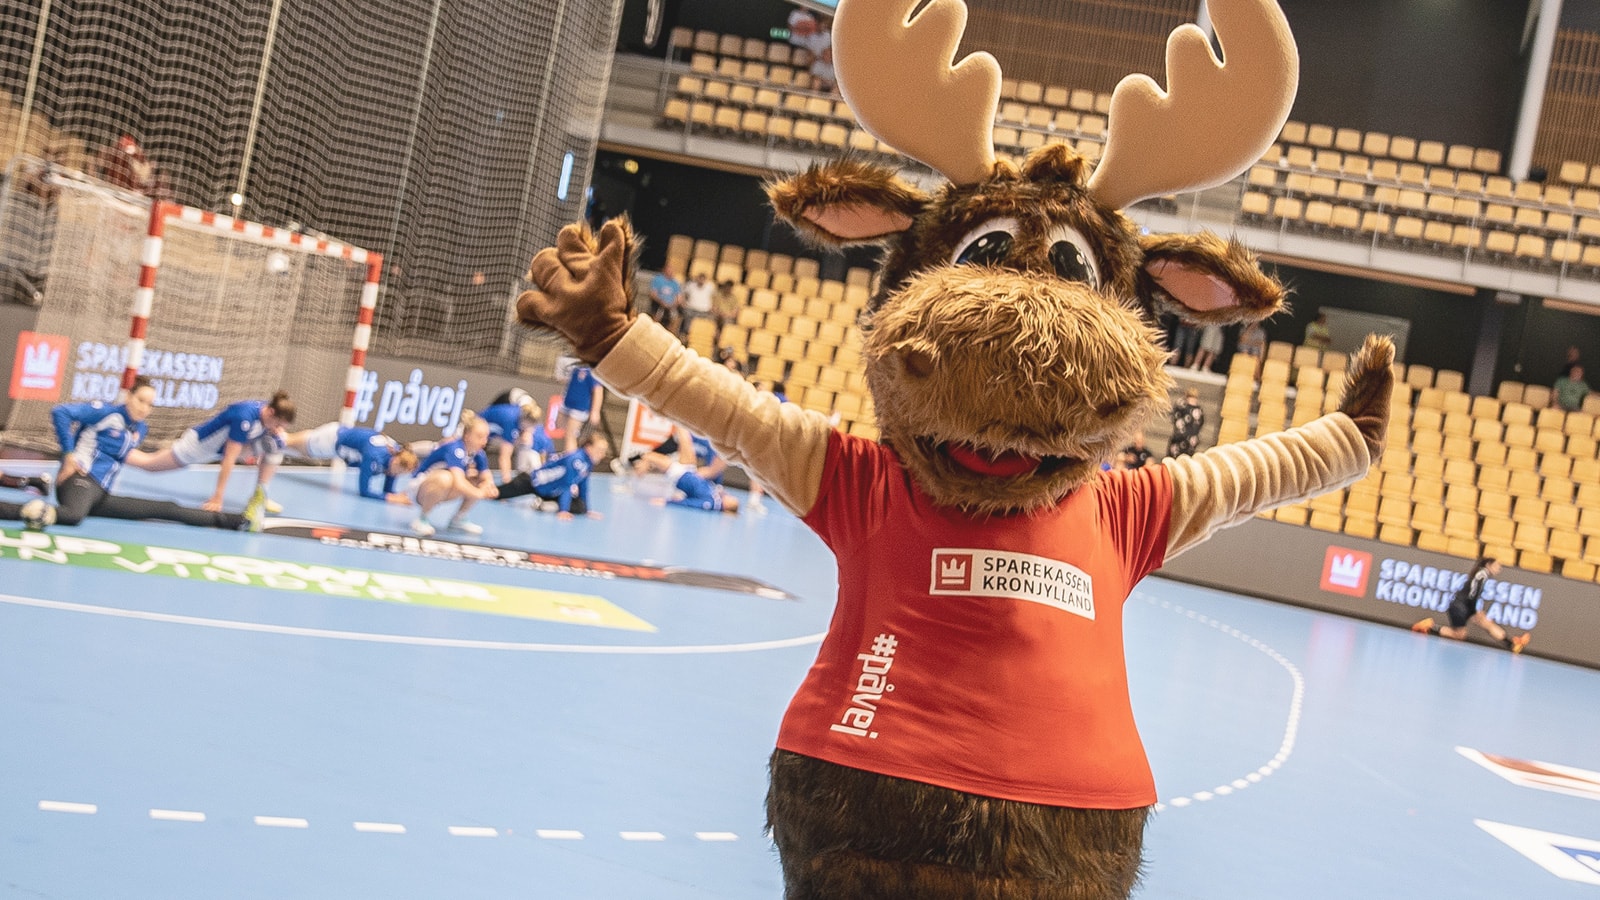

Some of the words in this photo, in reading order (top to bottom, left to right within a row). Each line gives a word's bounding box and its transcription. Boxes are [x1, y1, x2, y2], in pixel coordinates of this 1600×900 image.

[71, 372, 219, 410] KROLLAND
[982, 574, 1093, 613] KRONJYLLAND
[983, 556, 1091, 595] SPAREKASSEN
[1379, 557, 1542, 610] SPAREKSSEN
[1375, 578, 1538, 631] KRONJAND
[829, 633, 899, 739] #påvej
